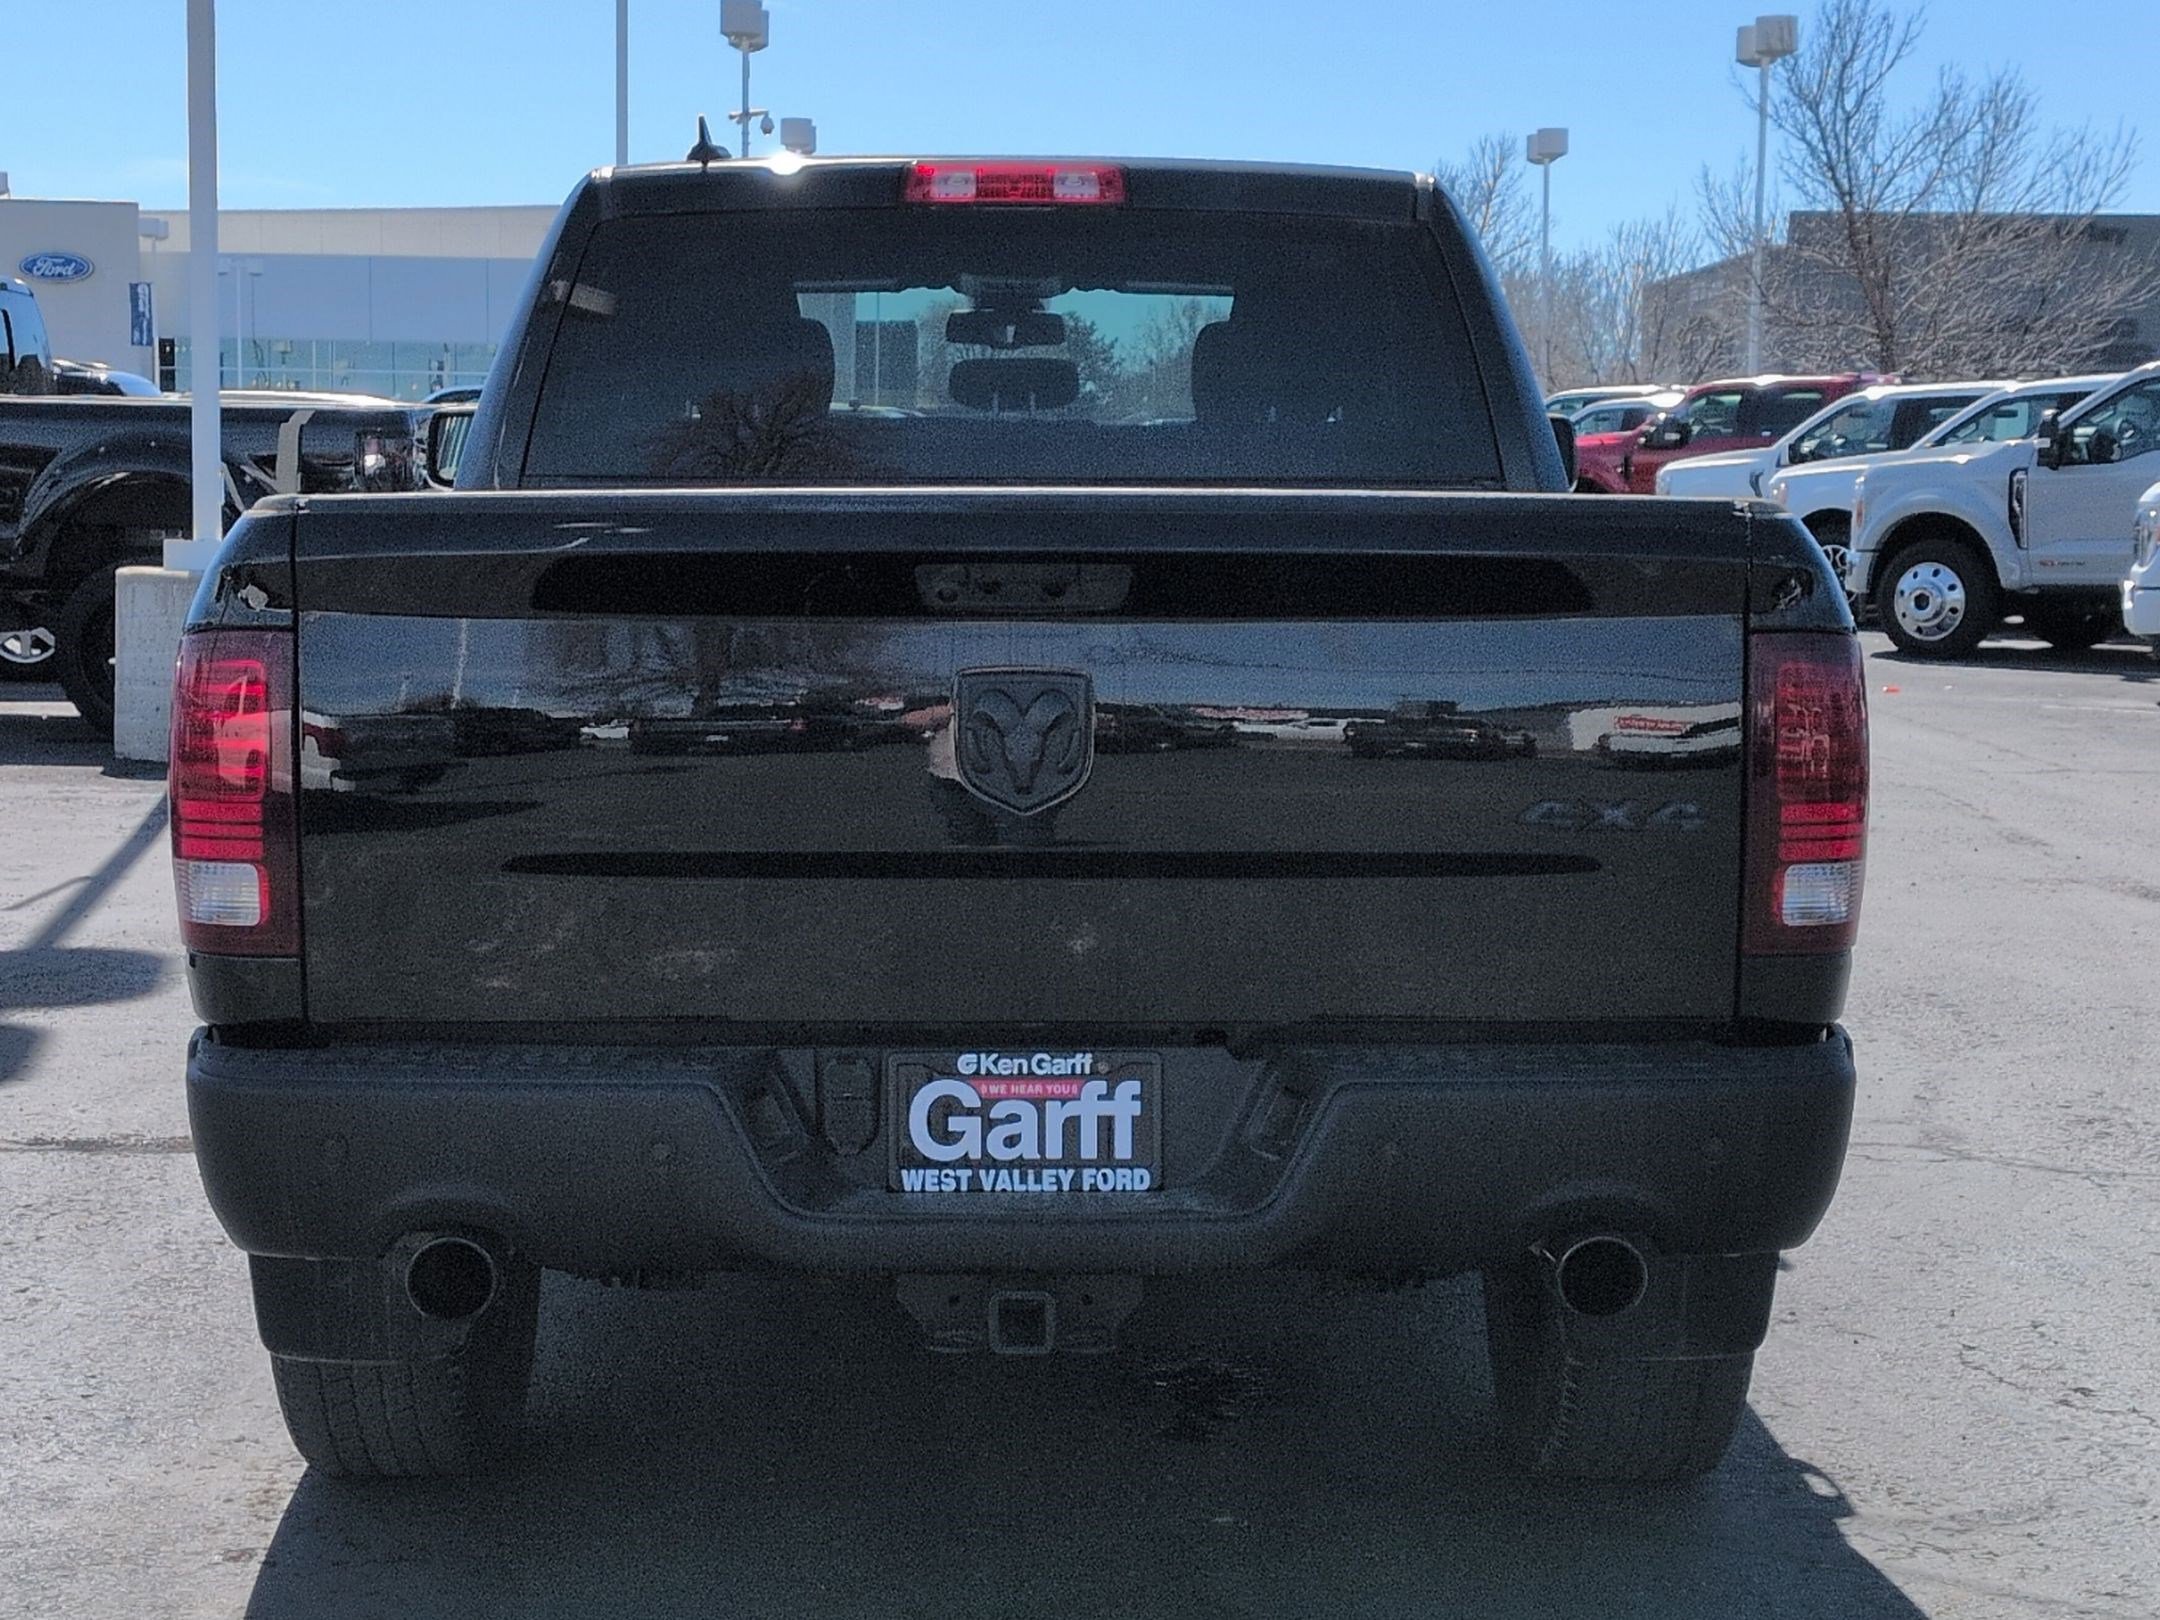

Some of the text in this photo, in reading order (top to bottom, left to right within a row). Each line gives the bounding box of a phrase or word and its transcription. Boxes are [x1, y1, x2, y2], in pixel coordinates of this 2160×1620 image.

[32, 255, 76, 276] Ford
[979, 1053, 1093, 1075] Ken Garff
[1011, 1084, 1042, 1095] HEAR
[909, 1079, 1141, 1161] Garff
[901, 1168, 1151, 1191] WEST VALLEY FORD
